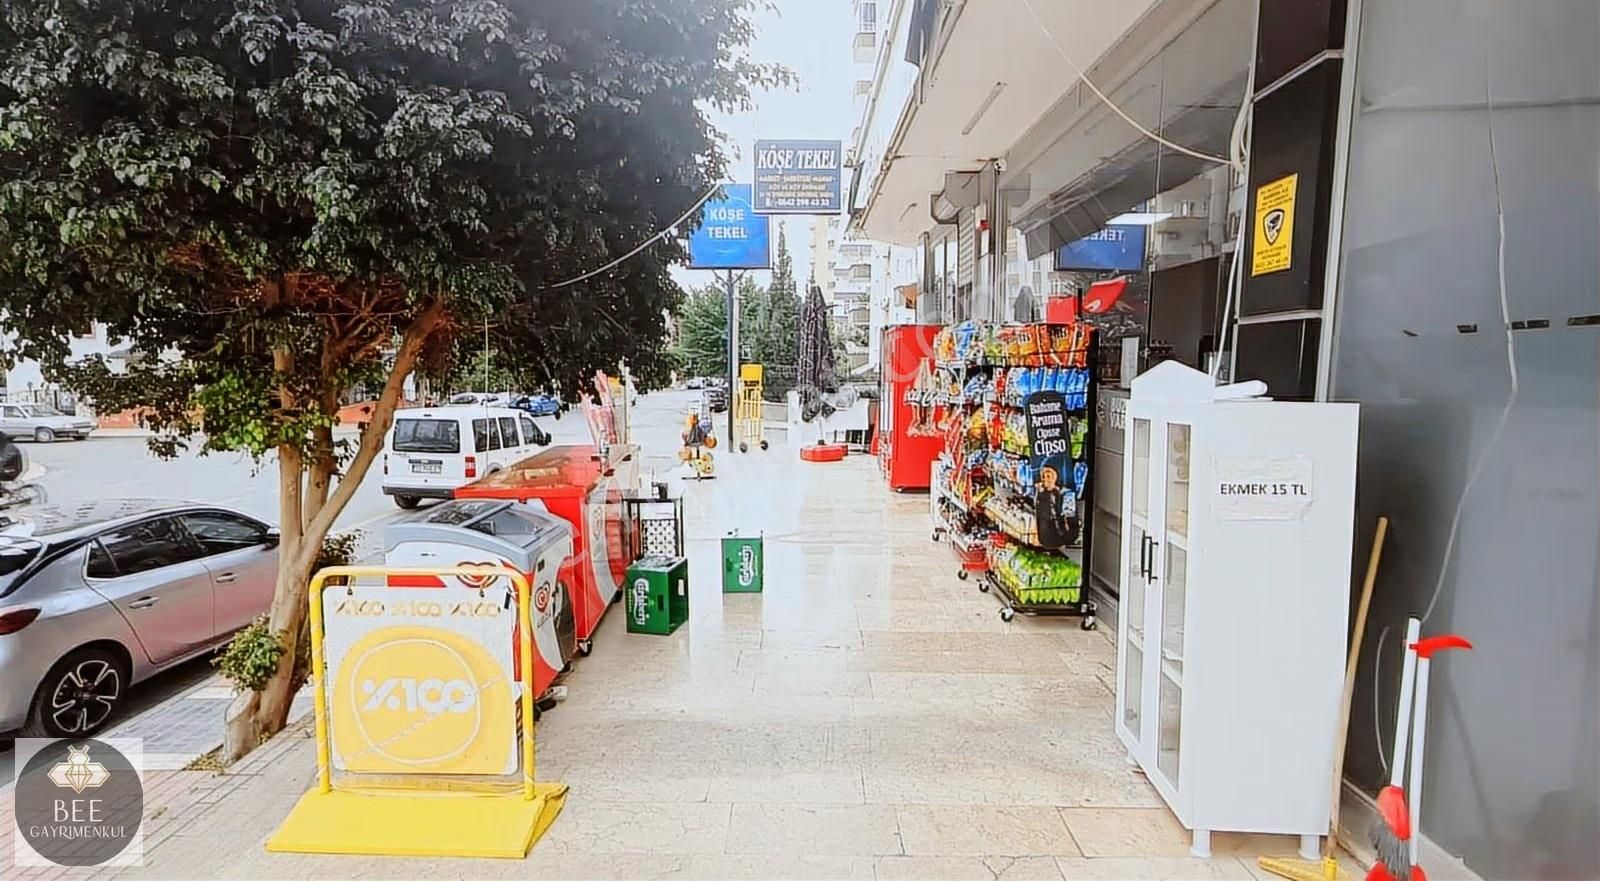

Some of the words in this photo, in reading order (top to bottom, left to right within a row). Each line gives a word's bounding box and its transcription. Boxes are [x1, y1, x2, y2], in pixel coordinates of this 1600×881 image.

[758, 145, 793, 174] KÖŞE
[796, 149, 837, 169] TEKEL
[710, 206, 745, 222] KÖŞE
[707, 226, 748, 239] TEKEL
[1029, 402, 1061, 415] Bahane
[1031, 414, 1064, 428] Arama
[1034, 439, 1067, 457] Cipso
[1220, 484, 1268, 495] EKMEK
[1271, 484, 1287, 495] 15
[1291, 484, 1307, 496] TL
